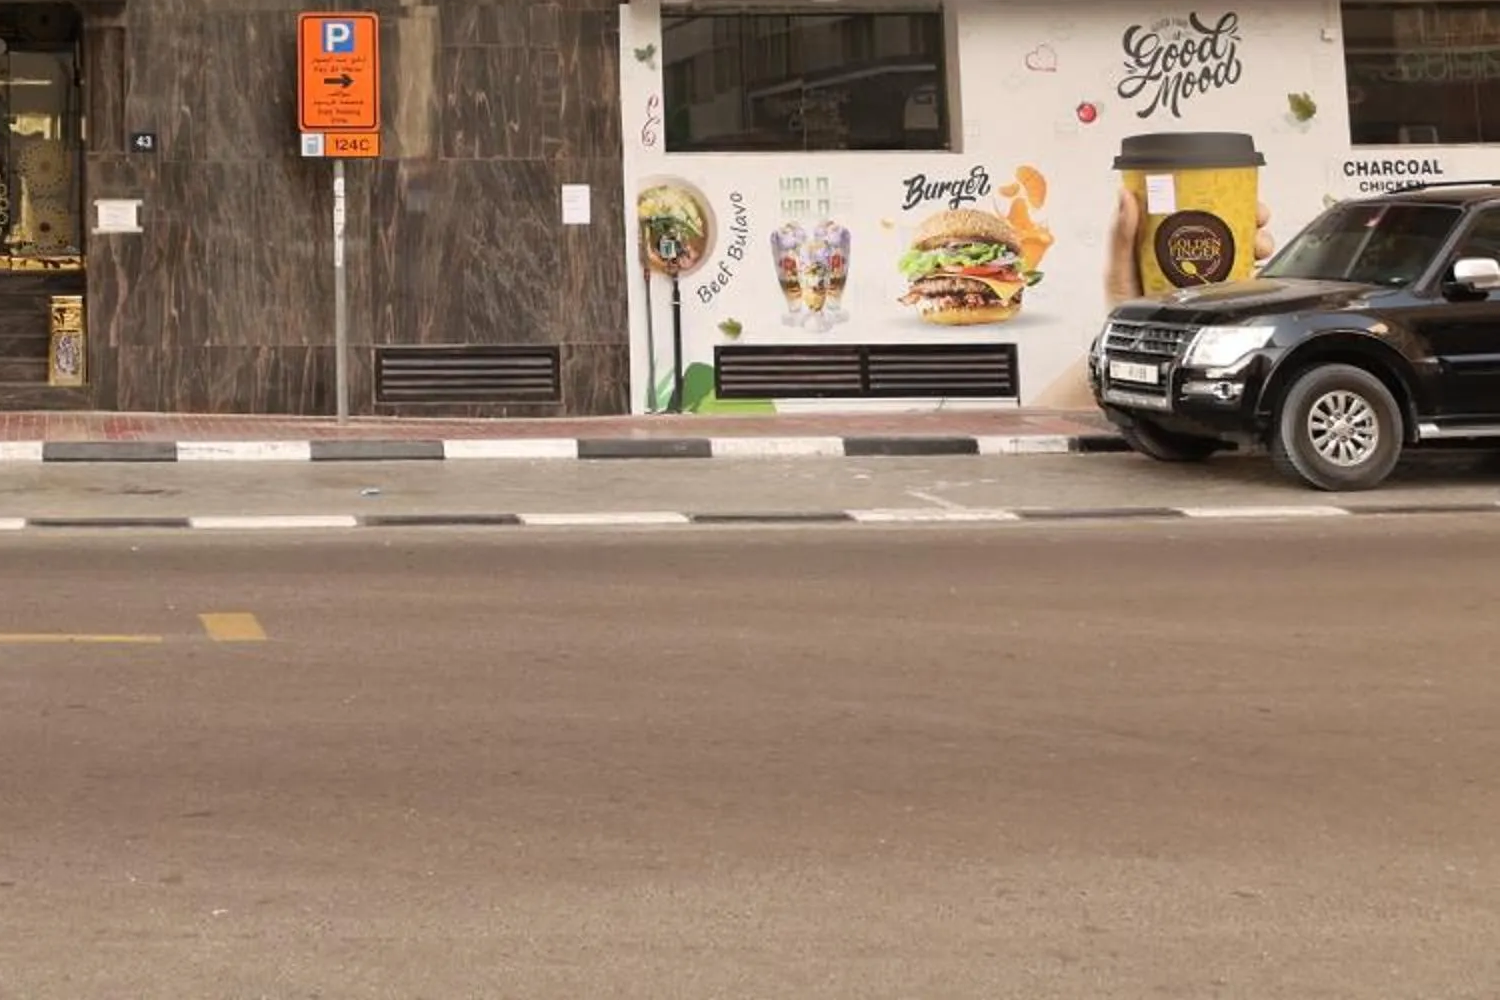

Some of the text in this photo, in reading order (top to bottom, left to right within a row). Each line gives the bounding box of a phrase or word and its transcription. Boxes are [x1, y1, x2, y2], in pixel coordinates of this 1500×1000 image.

[325, 23, 350, 51] P
[1117, 10, 1239, 99] Good
[1136, 41, 1242, 119] Mood
[335, 138, 370, 152] 124C
[902, 165, 991, 210] Burger
[1343, 159, 1443, 177] CHARCOAL
[697, 260, 733, 304] Beef
